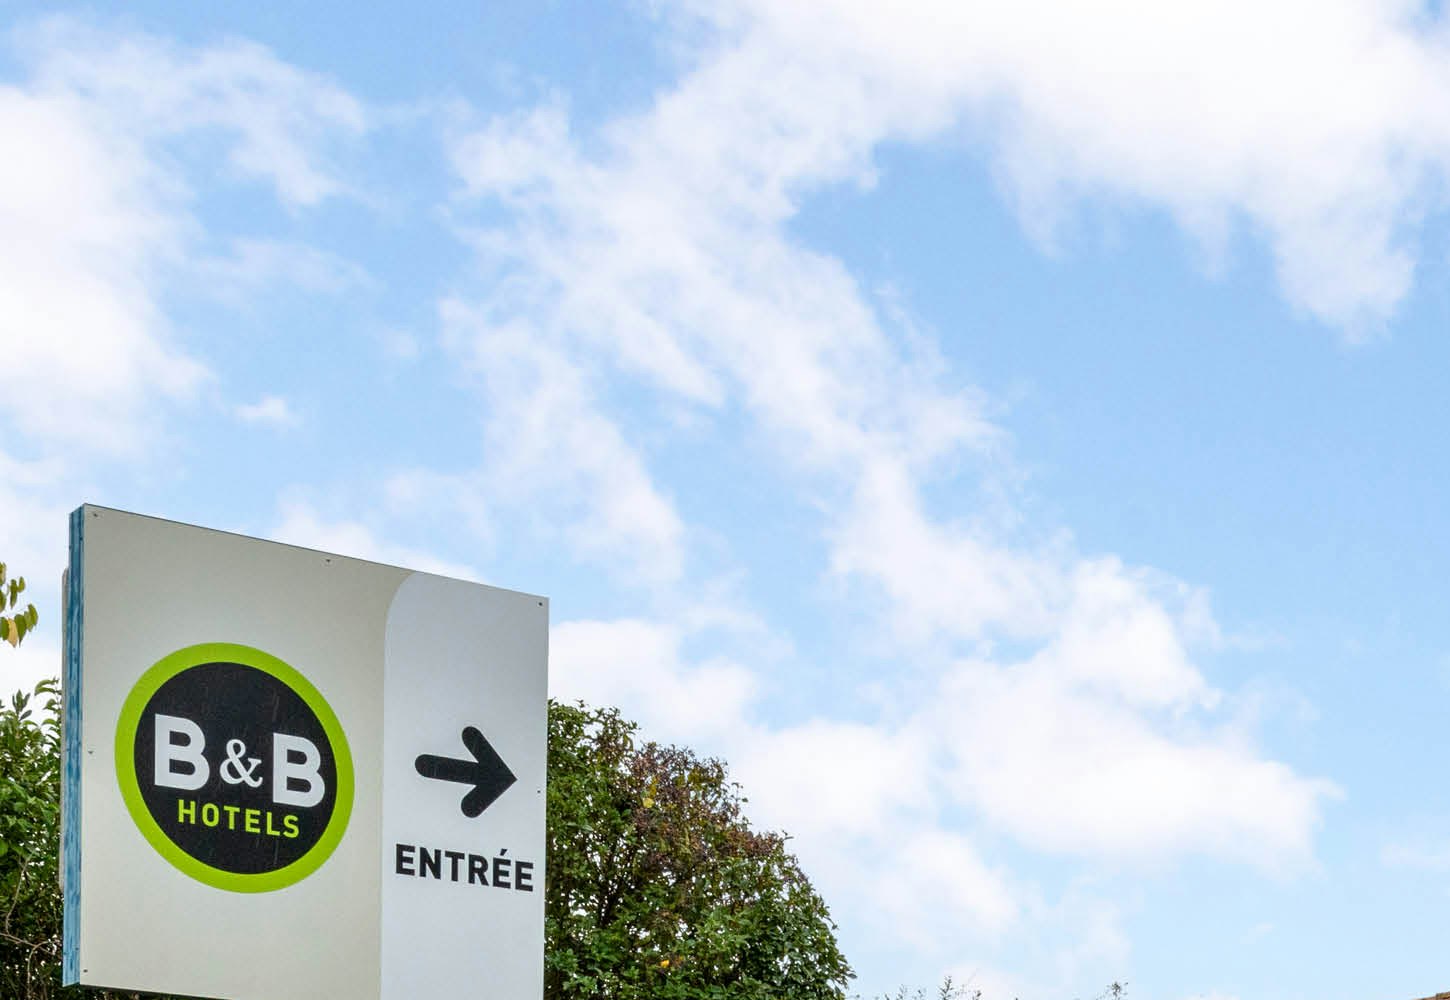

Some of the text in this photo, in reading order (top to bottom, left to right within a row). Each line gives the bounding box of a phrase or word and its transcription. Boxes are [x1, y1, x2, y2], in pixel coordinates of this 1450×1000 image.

[154, 713, 325, 808] B&B
[177, 799, 299, 839] HOTELS
[395, 843, 535, 892] ENTRÉE
